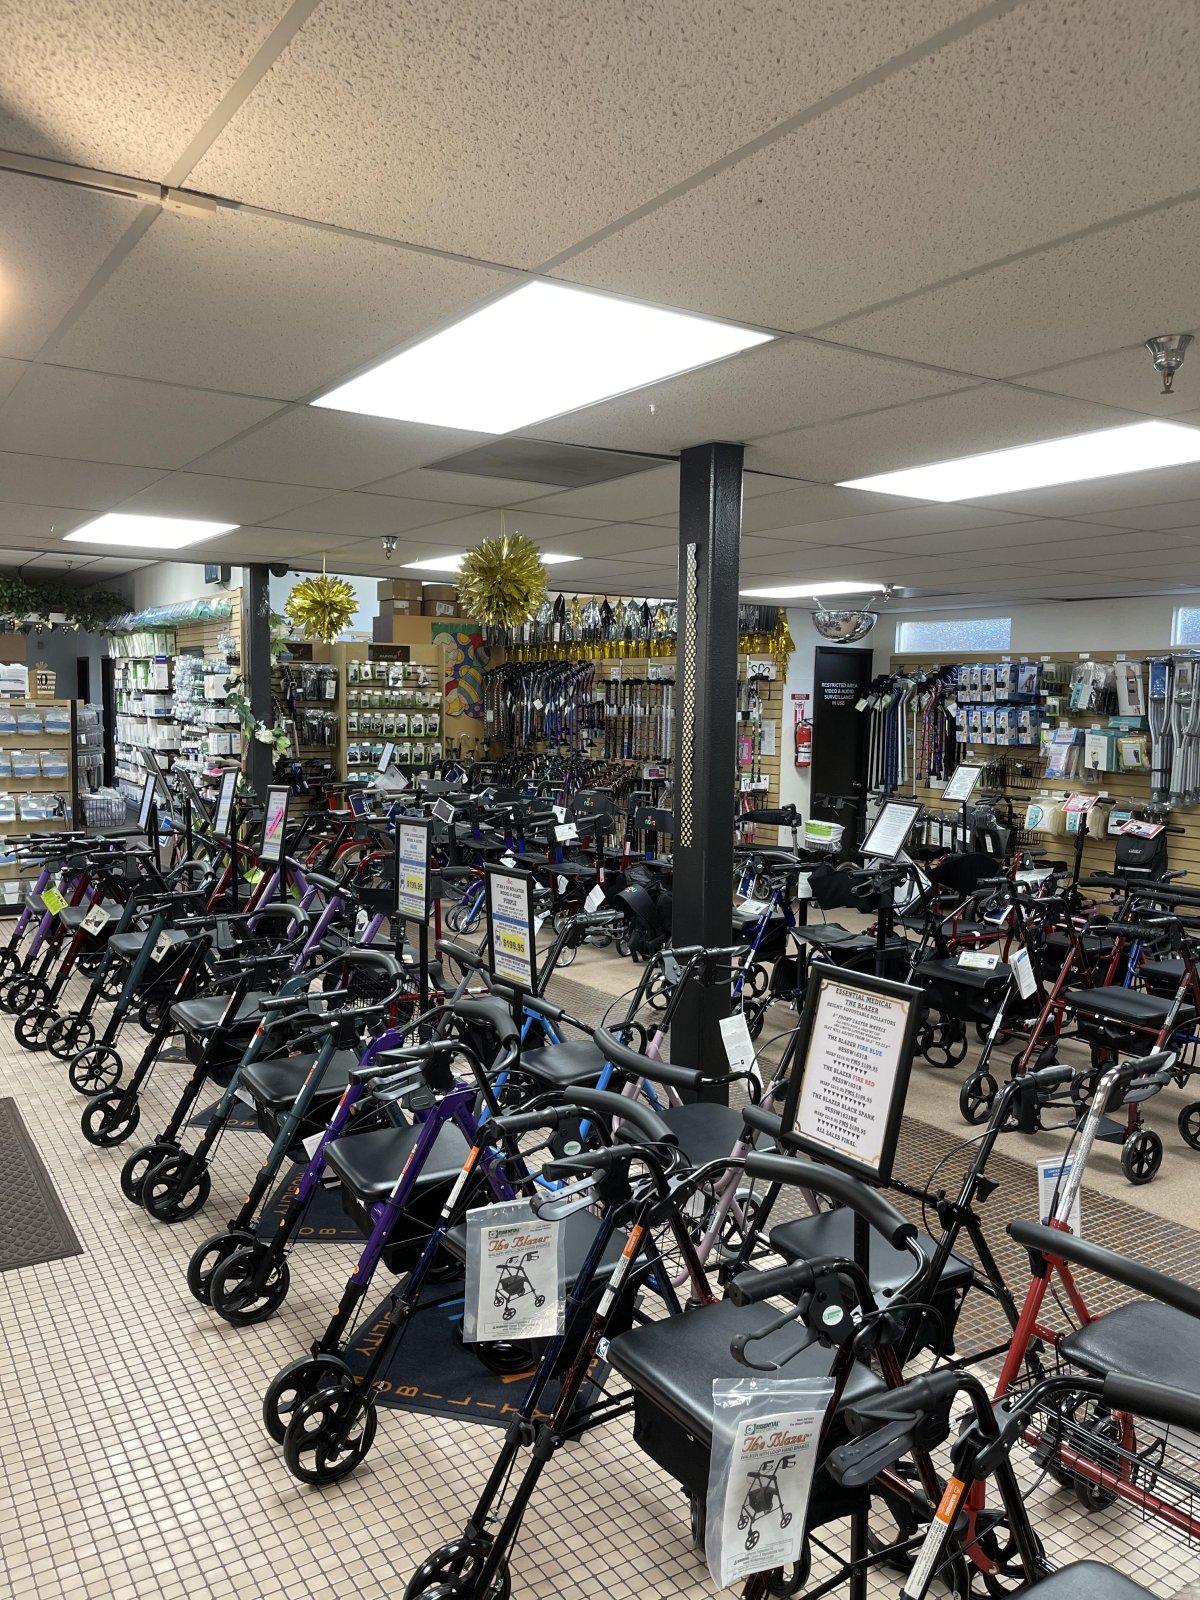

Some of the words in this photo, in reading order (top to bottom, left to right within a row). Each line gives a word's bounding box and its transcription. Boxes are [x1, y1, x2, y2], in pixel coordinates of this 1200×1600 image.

[406, 880, 423, 891] $199.95
[503, 938, 525, 953] $199.95
[836, 988, 864, 1001] ESSENTIAL
[866, 997, 892, 1008] MEDICAL
[845, 999, 857, 1007] THE
[858, 1003, 879, 1014] BLAZER
[843, 1007, 869, 1018] ADJUSTABLE
[870, 1015, 896, 1026] ROLLATORS
[838, 1037, 856, 1048] BLAZER
[857, 1044, 868, 1052] FIRE
[869, 1048, 883, 1057] BLUE
[861, 1062, 878, 1072] $199.95
[834, 1068, 851, 1078] BLAZER
[852, 1074, 864, 1082] FIRE
[865, 1079, 875, 1087] RED
[855, 1093, 872, 1104] $199.95
[823, 1096, 842, 1107] BLAZER
[841, 1104, 857, 1114] BLACK
[858, 1110, 875, 1122] SPARK
[826, 1130, 840, 1141] SALES
[849, 1123, 866, 1135] $199.95
[488, 1239, 509, 1251] The
[511, 1235, 549, 1248] Blazer
[755, 1421, 779, 1430] ESSENTIAL
[742, 1435, 765, 1452] The
[767, 1431, 806, 1448] Blazer
